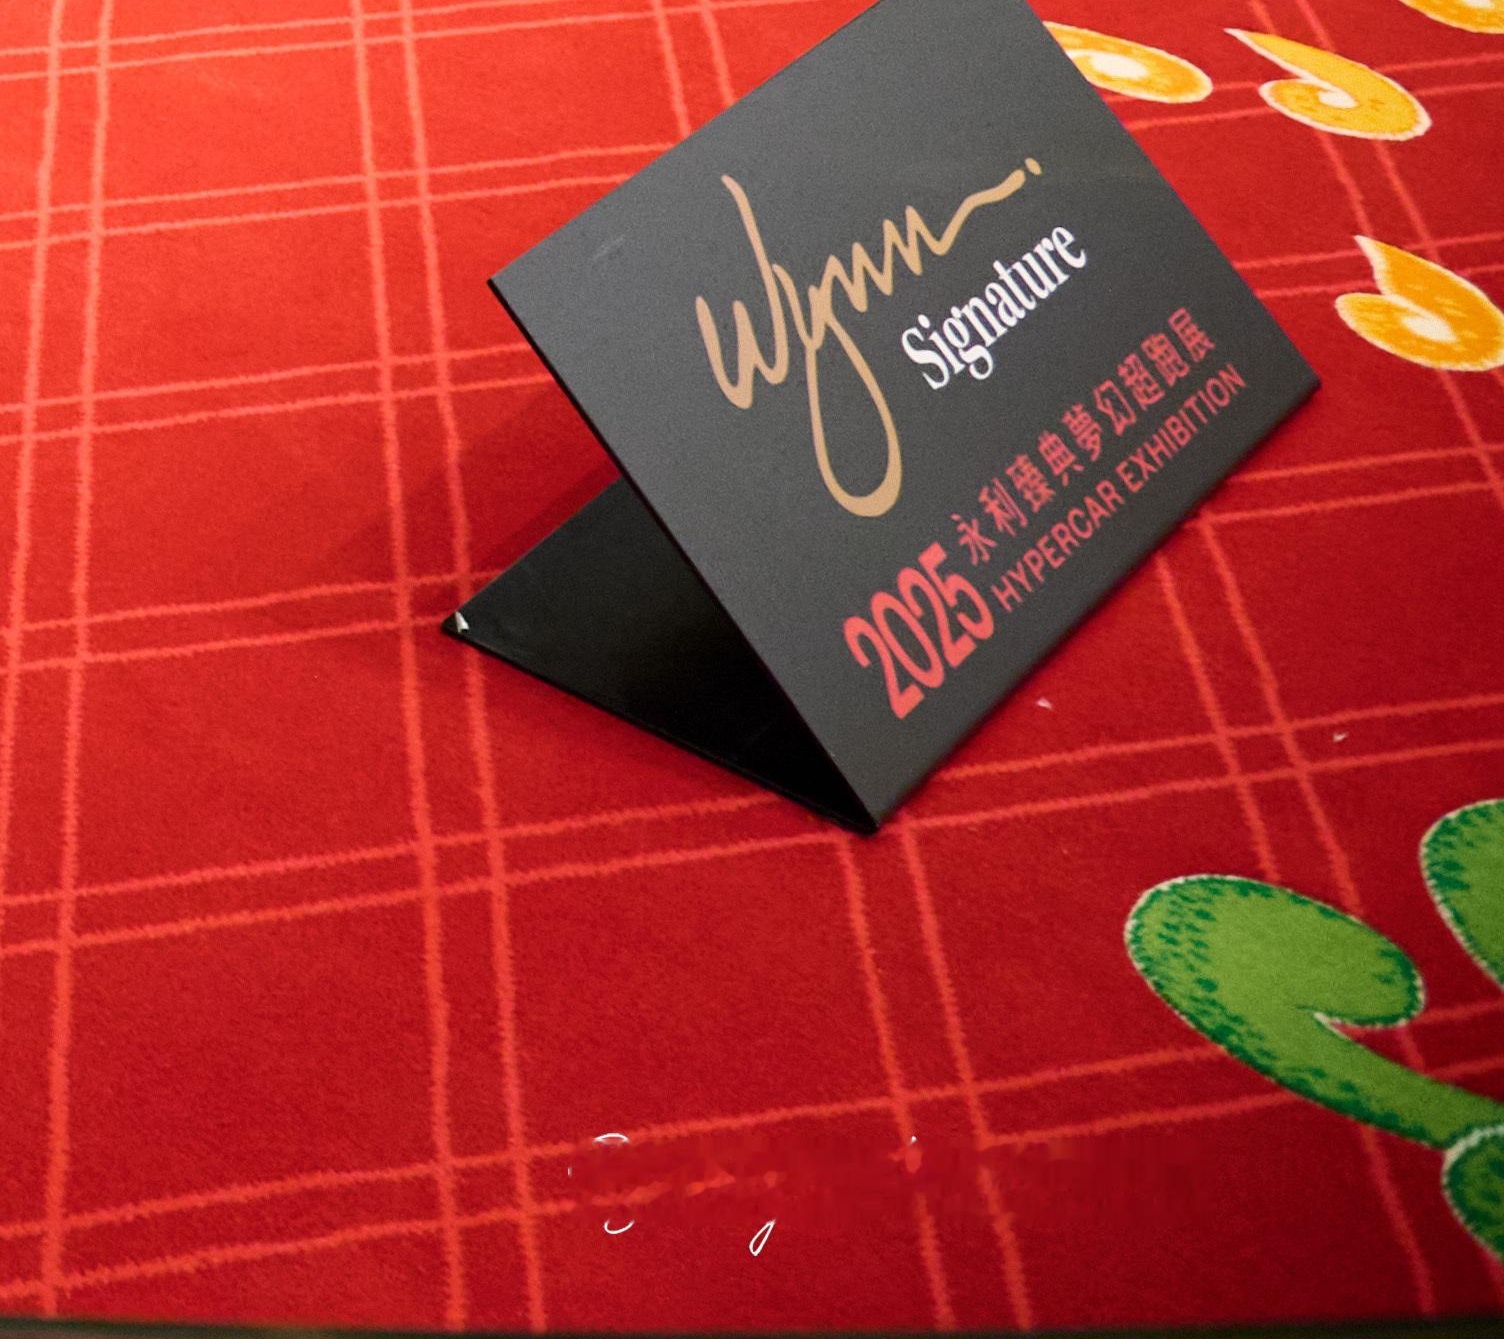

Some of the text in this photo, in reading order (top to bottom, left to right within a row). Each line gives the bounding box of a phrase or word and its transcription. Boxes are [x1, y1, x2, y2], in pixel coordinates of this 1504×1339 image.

[696, 158, 1041, 517] Wynn
[900, 225, 1087, 390] Signature
[950, 307, 1216, 565] 永利臻典夢幻超跑展
[991, 363, 1247, 612] HYPERCAR EXHIBITION
[843, 542, 994, 719] 2025
